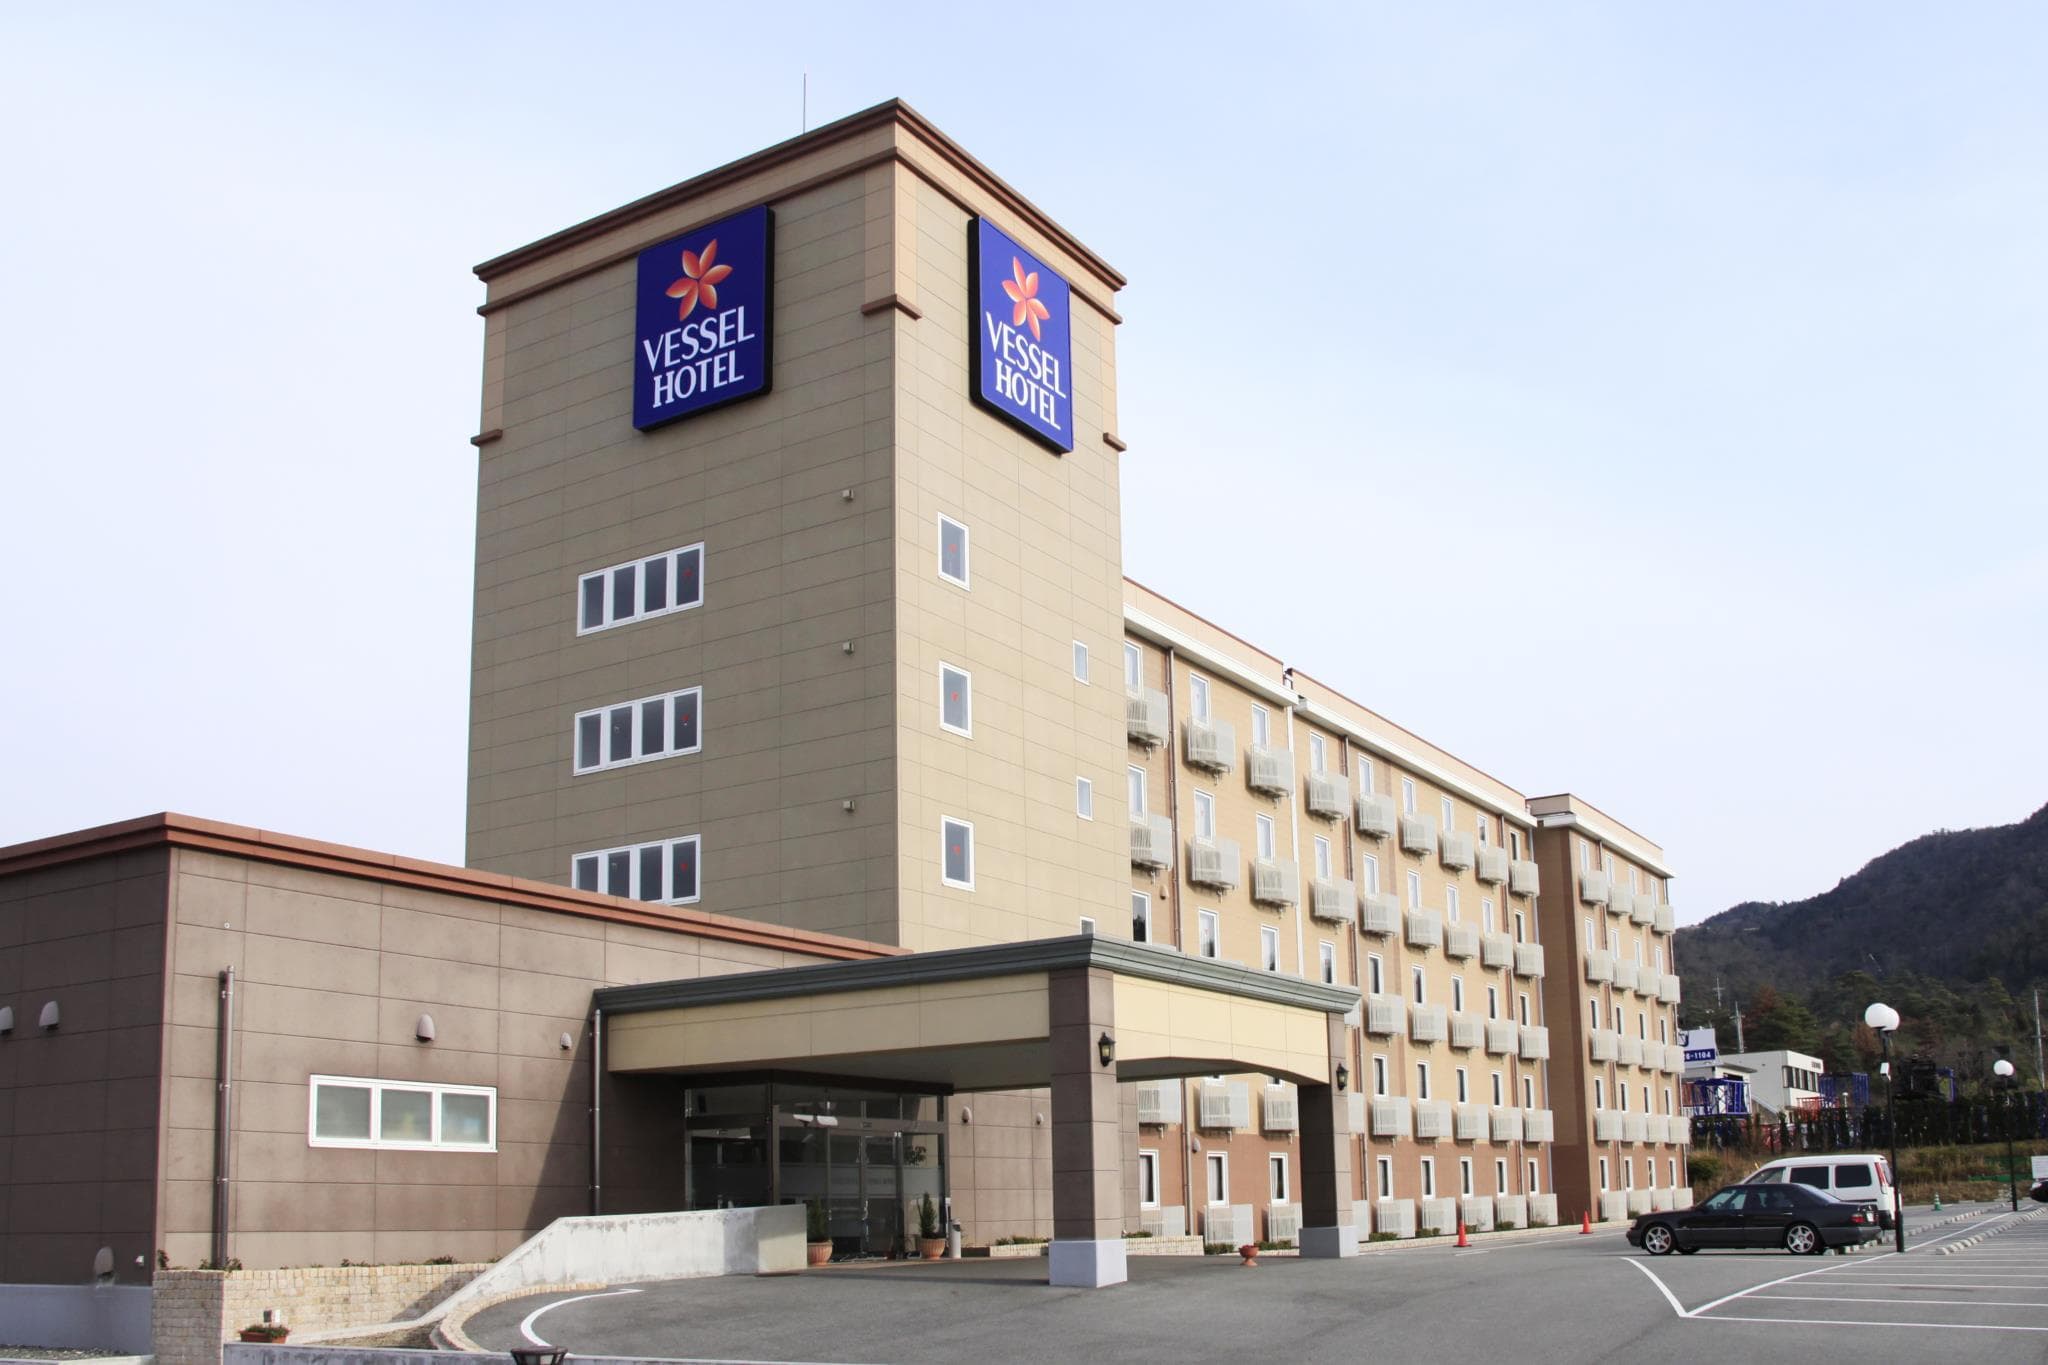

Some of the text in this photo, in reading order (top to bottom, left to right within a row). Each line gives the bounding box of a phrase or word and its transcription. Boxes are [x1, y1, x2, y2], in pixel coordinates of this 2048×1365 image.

[643, 306, 755, 372] VESSEL
[986, 311, 1066, 399] VESSEL
[652, 350, 744, 408] HOTEL
[995, 358, 1061, 430] HOTEL
